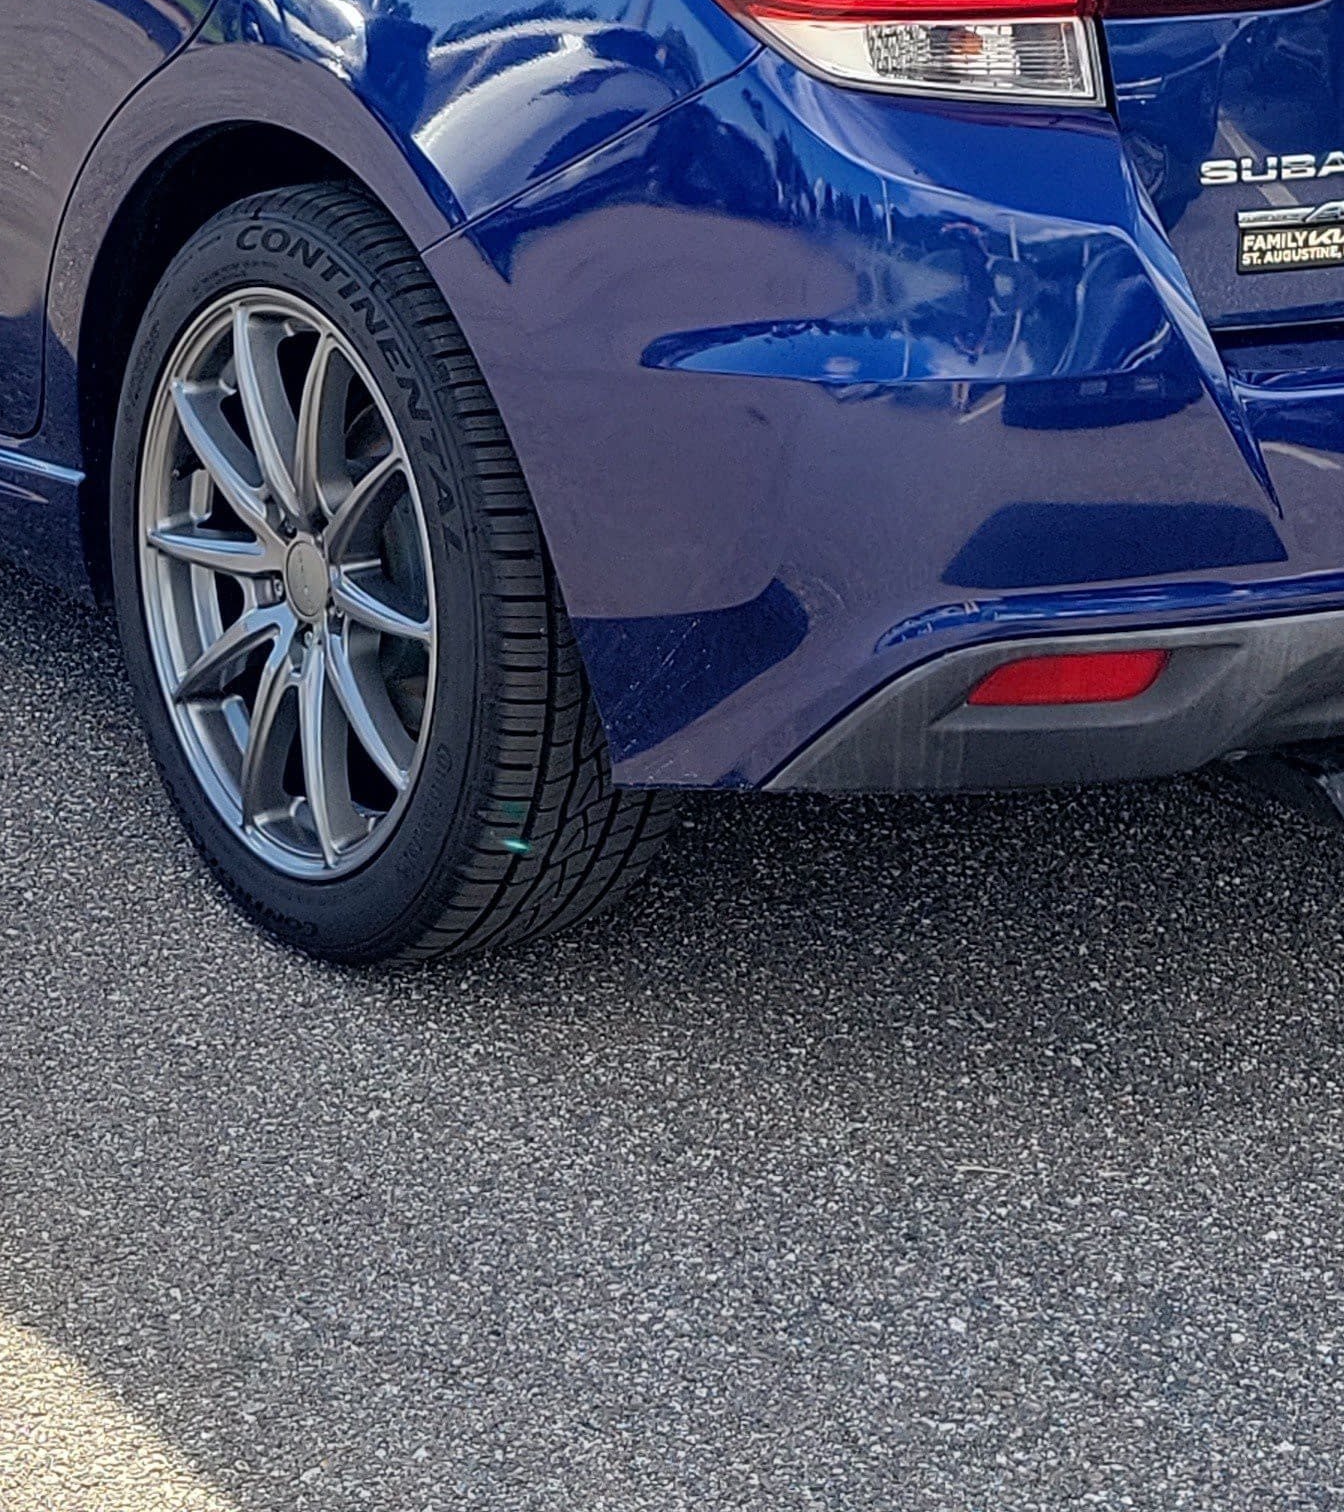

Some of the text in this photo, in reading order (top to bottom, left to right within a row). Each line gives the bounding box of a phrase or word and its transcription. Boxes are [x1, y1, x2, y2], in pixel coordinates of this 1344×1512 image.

[1243, 231, 1308, 252] FAMILY
[1242, 252, 1263, 266] ST.
[1263, 245, 1343, 264] AUGUSTINE,
[235, 223, 465, 554] CONTINENTAL
